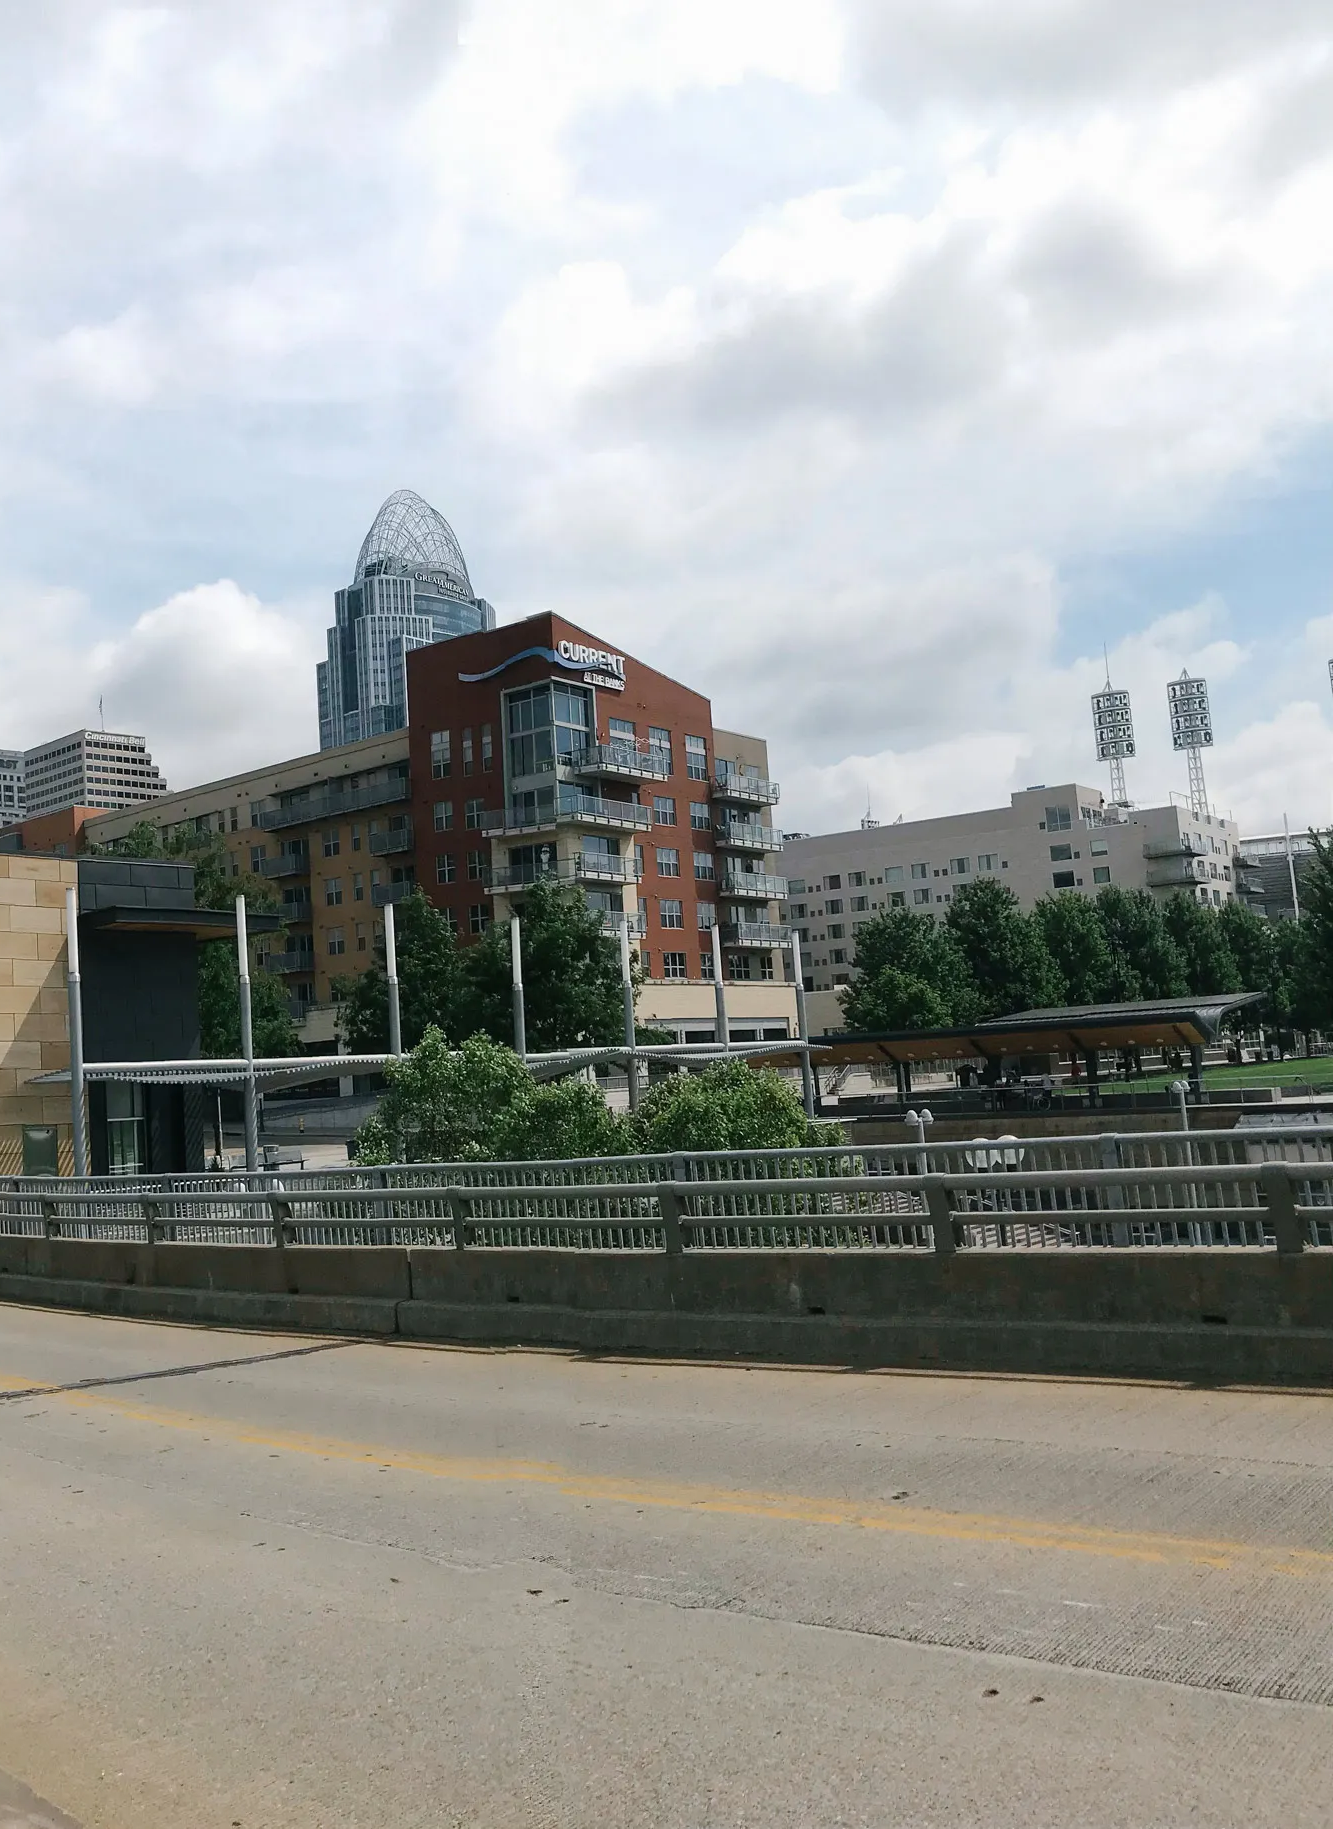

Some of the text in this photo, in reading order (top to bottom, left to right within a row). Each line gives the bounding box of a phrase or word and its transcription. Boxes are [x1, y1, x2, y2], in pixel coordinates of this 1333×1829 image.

[414, 571, 439, 585] GREAT
[558, 640, 625, 675] CURRENT
[583, 671, 625, 691] AT THE BANKS
[84, 731, 145, 746] Cincinnati Bell
